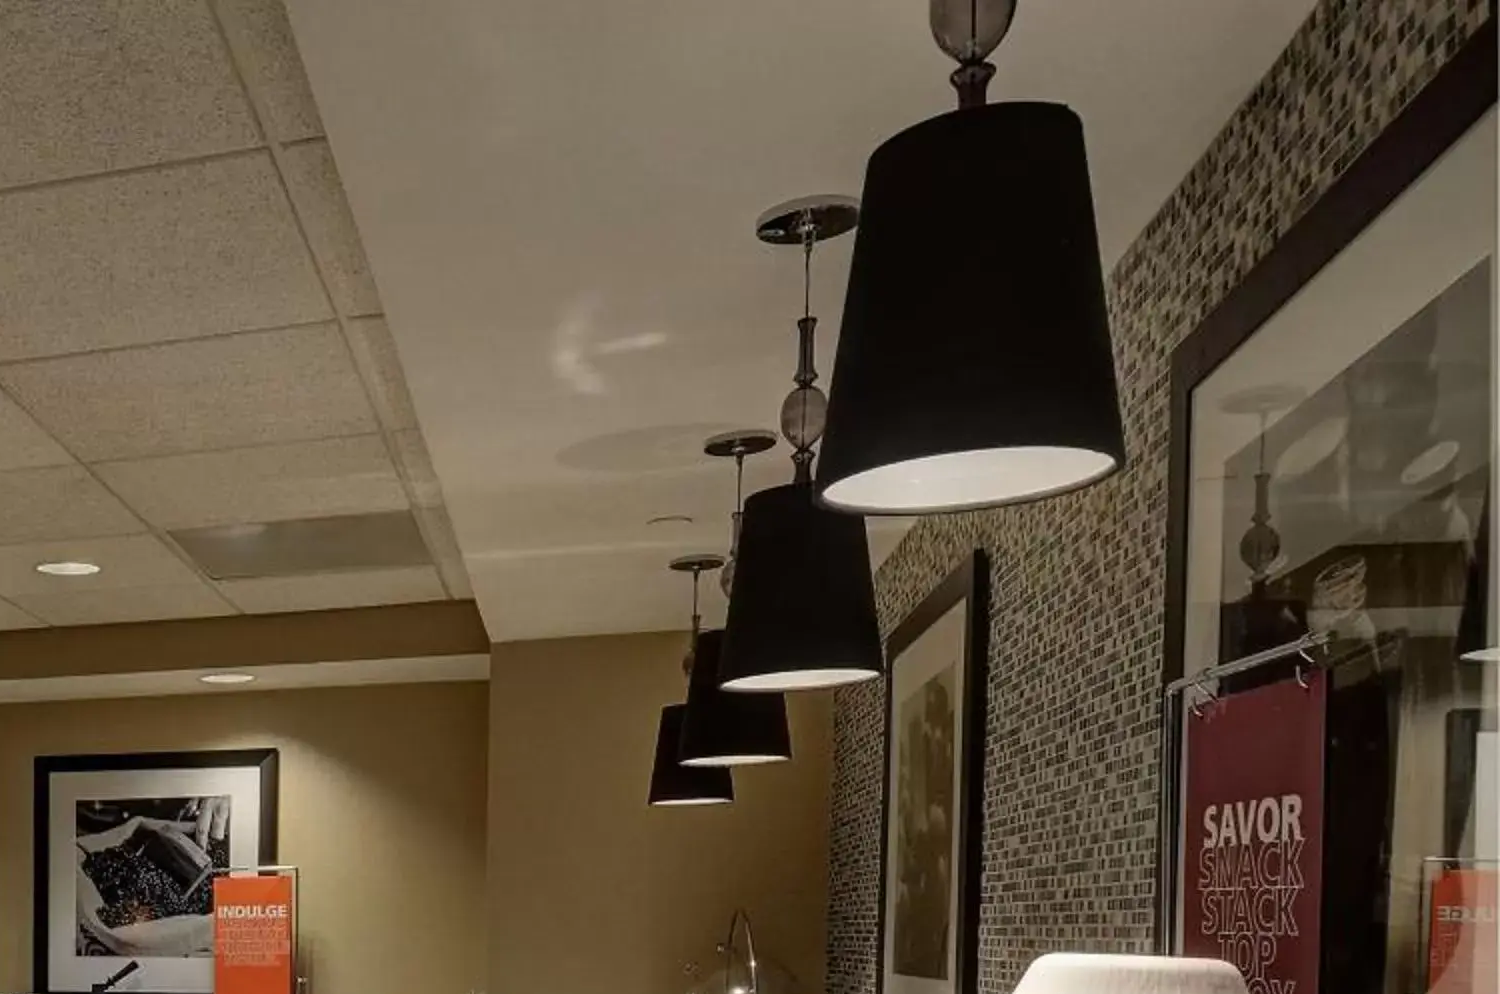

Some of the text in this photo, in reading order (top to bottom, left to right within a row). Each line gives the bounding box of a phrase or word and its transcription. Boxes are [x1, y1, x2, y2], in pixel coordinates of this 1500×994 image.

[1203, 793, 1303, 849] SAVOR
[1198, 837, 1306, 889] SNACK
[217, 904, 290, 919] INDULGE
[1201, 887, 1300, 937] STACK
[1217, 931, 1278, 981] TOP
